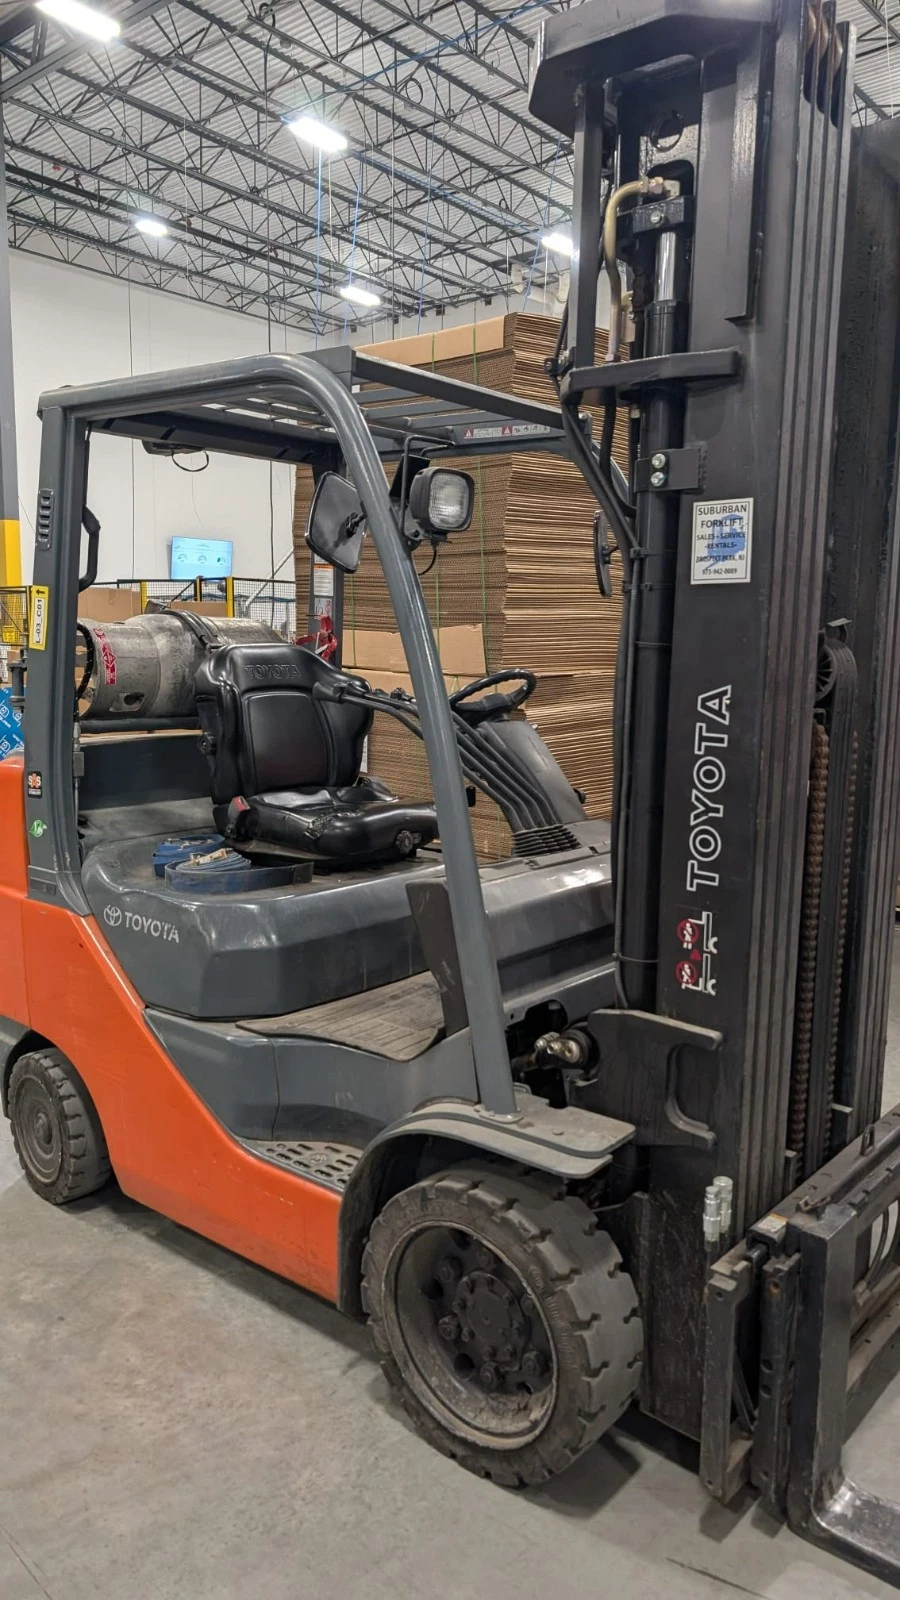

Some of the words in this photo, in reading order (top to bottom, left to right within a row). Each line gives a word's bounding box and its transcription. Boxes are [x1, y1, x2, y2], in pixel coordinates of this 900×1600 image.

[698, 504, 747, 515] SUBURBAN
[701, 518, 743, 528] FORKLIFT
[244, 664, 301, 679] TOYOTA
[686, 684, 732, 892] TOYOTA
[124, 911, 180, 944] TOYOTA
